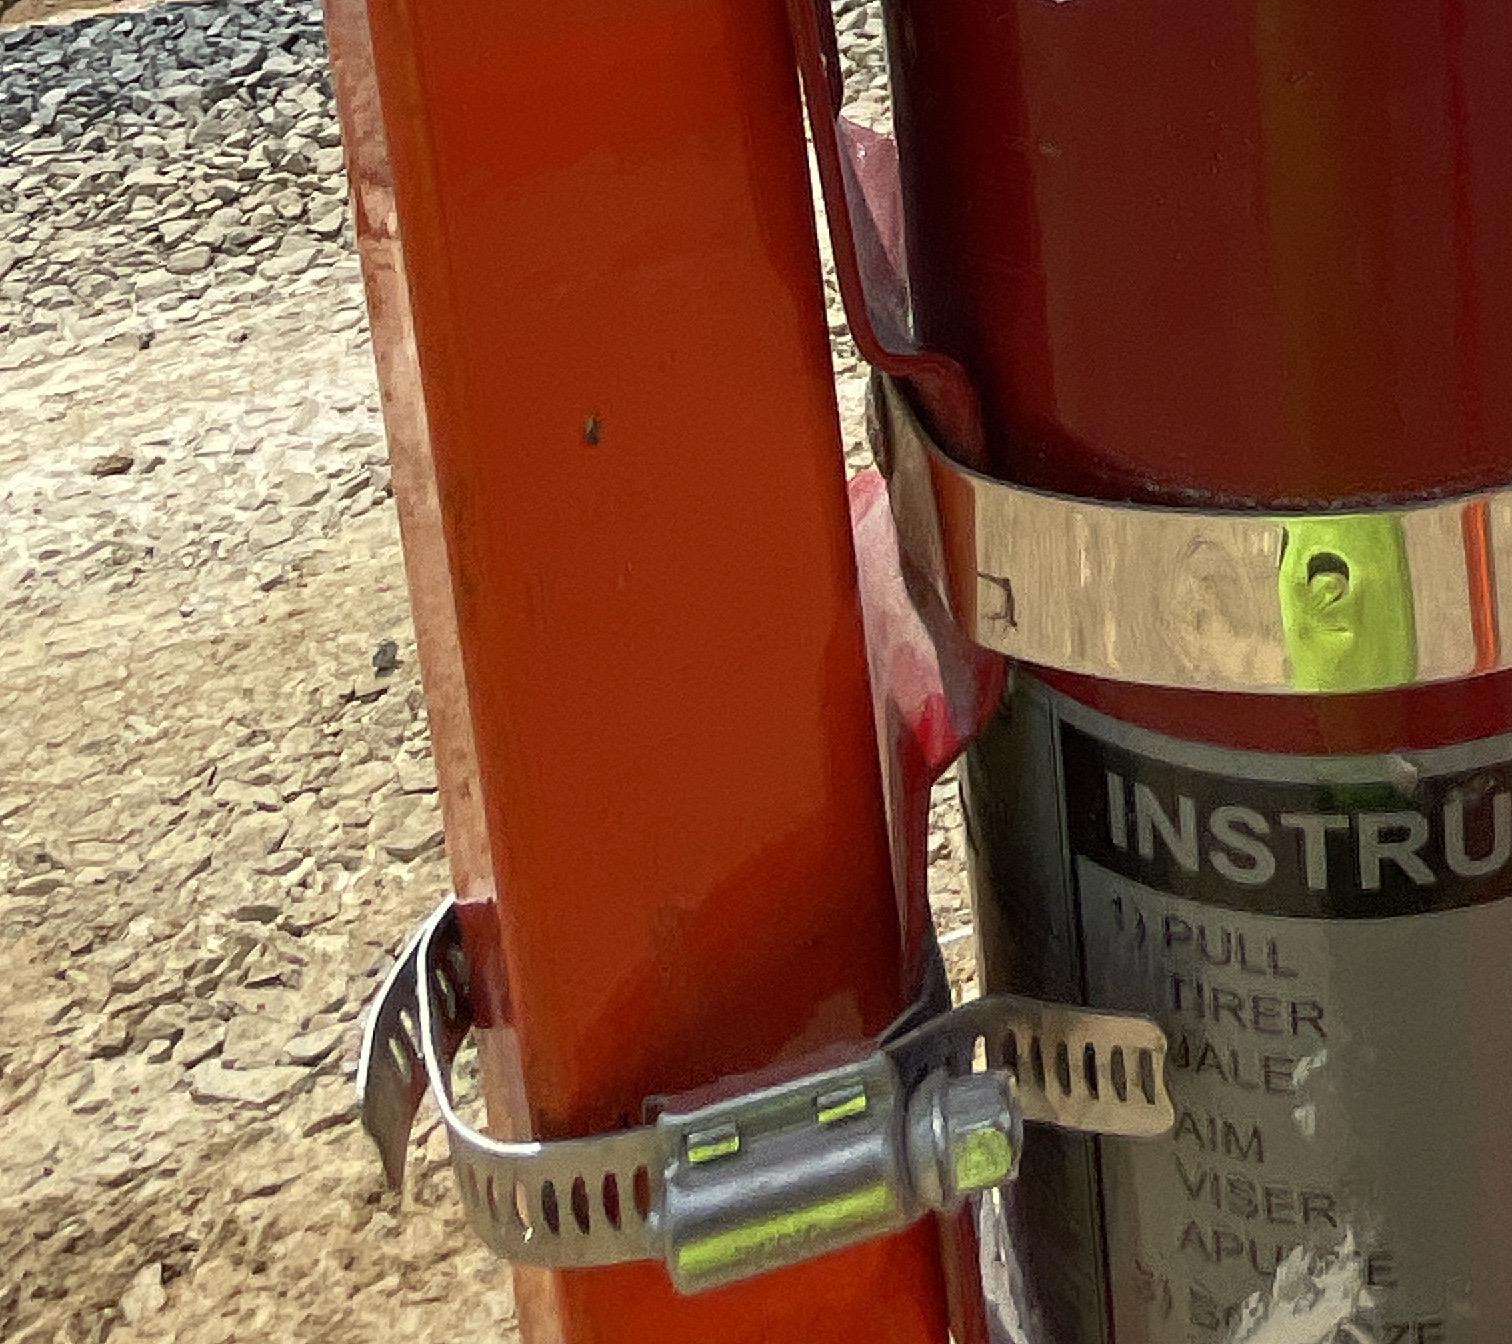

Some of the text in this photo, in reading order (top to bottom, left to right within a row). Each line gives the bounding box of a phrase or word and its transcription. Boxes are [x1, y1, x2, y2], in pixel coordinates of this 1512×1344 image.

[1163, 913, 1299, 979] PULL
[1167, 972, 1328, 1039] TIRER
[1173, 1111, 1265, 1164] AIM
[1173, 1153, 1338, 1229] VISER
